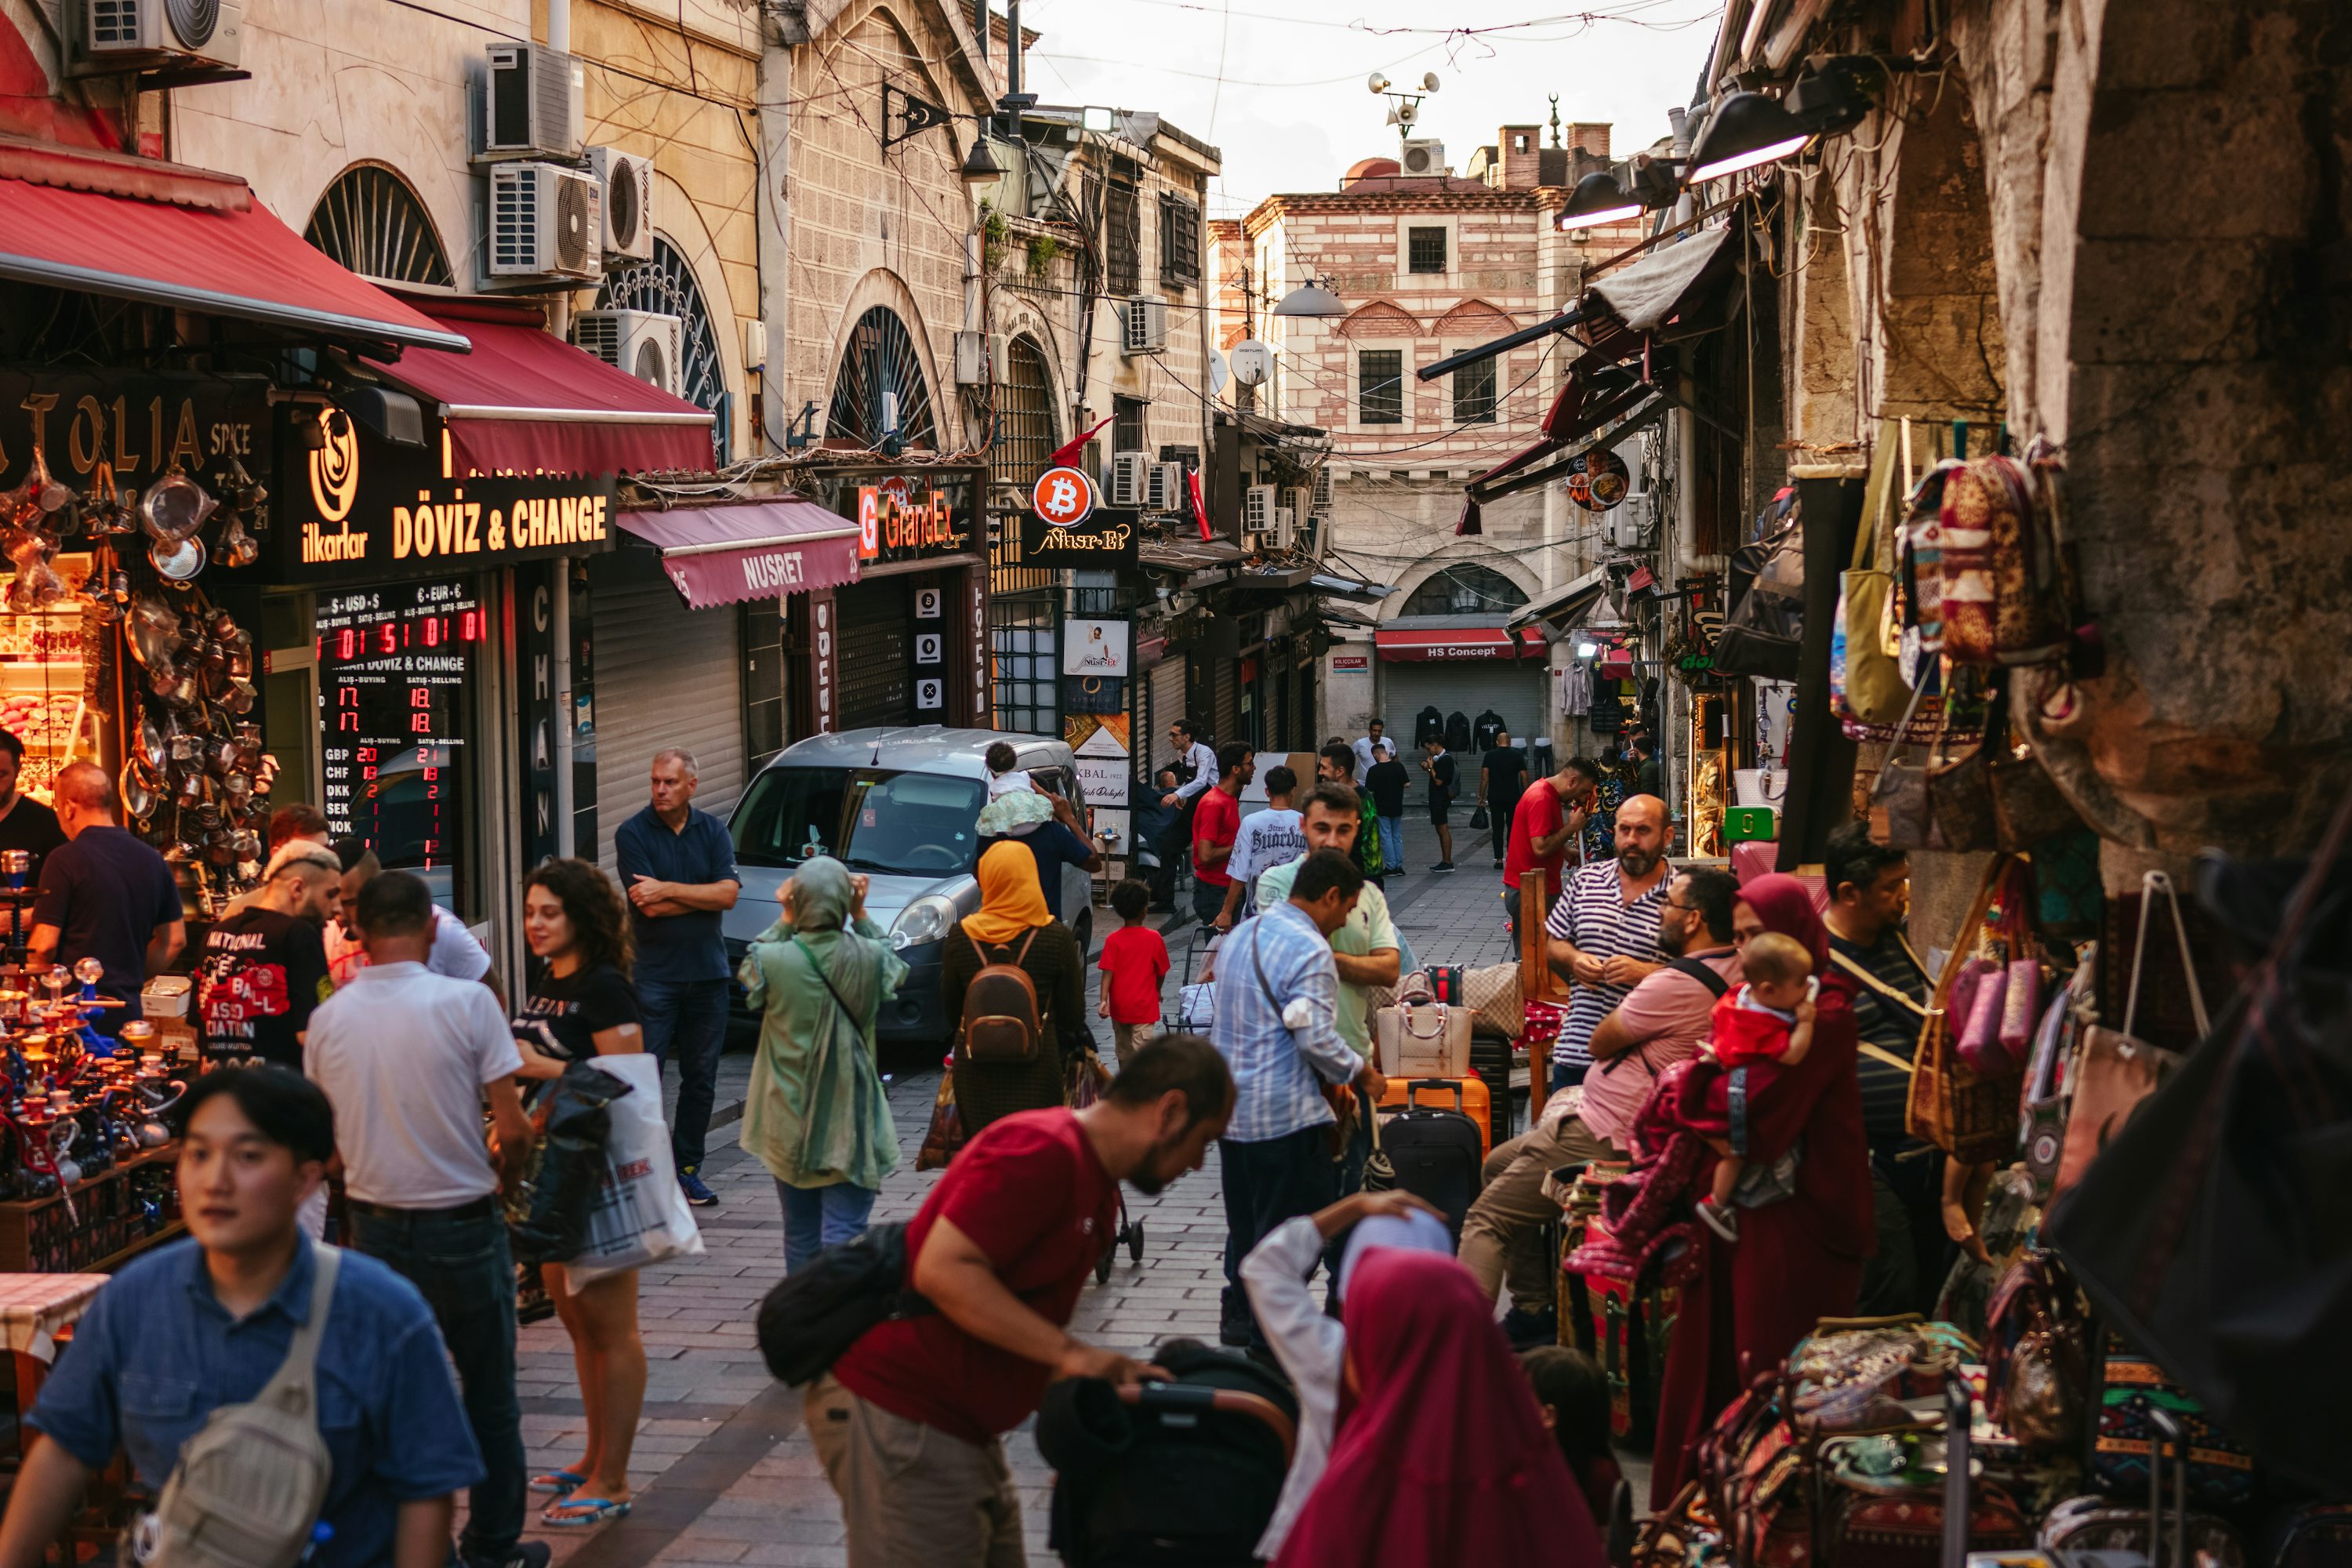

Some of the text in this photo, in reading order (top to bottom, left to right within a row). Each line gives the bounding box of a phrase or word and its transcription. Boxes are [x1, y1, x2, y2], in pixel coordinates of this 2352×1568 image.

[0, 393, 205, 474] TOLIA
[393, 488, 607, 560] DÖVİZ & CHANGE
[862, 491, 952, 550] G GrandEx
[302, 521, 368, 564] ilkarlar
[742, 551, 804, 590] NUSRET
[1428, 646, 1496, 657] HS Concept
[405, 656, 413, 671] &
[416, 656, 464, 671] CHANGE
[325, 747, 437, 764] GBP 20 21
[326, 766, 437, 781] CHF 18 18
[326, 784, 438, 799] DKK 2 2
[1096, 786, 1125, 800] Delight
[326, 803, 349, 815] SEK
[207, 931, 267, 951] NATIONAL
[231, 977, 276, 1013] BALL
